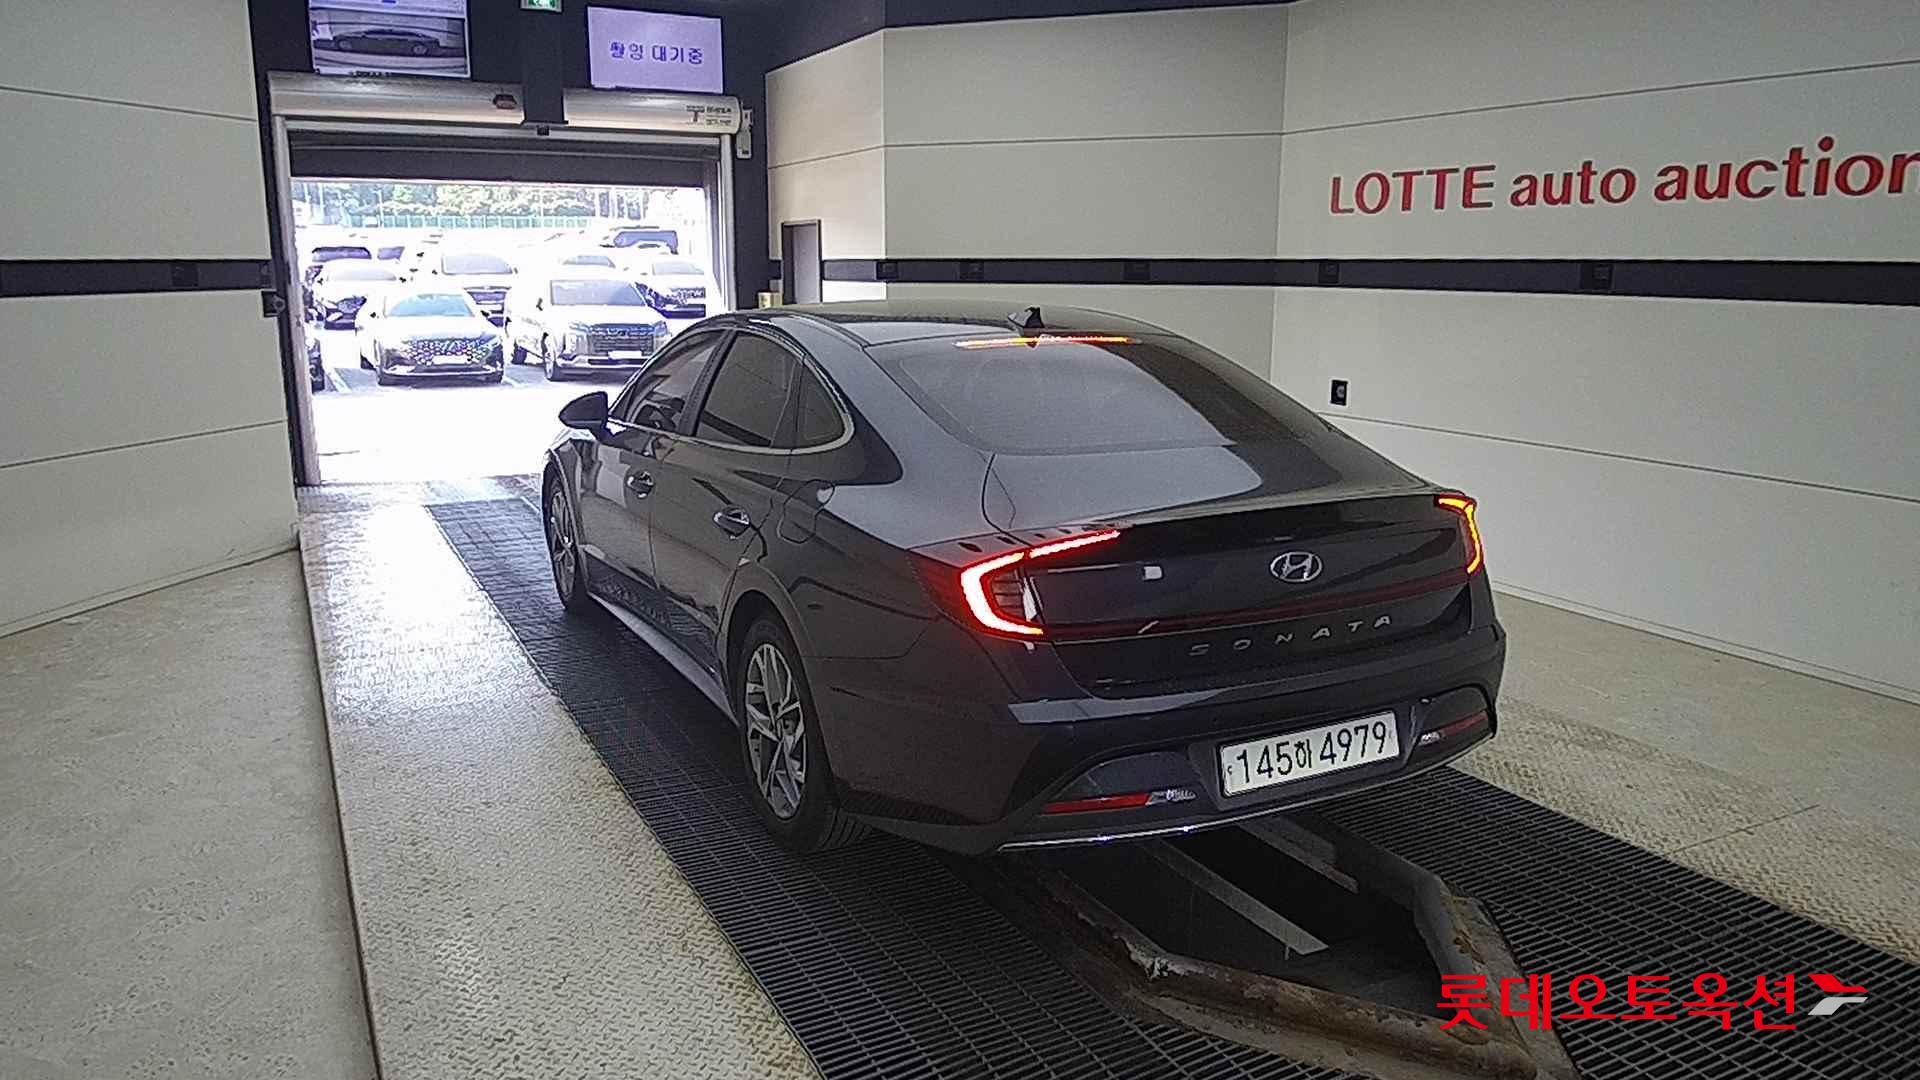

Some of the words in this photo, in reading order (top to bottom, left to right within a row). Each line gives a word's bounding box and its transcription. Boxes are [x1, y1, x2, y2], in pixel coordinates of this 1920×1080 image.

[651, 44, 703, 65] 대기중
[1331, 164, 1496, 214] LOTTE
[1510, 159, 1637, 207] auto
[1189, 614, 1391, 657] SONATA
[1319, 721, 1387, 766] 4979
